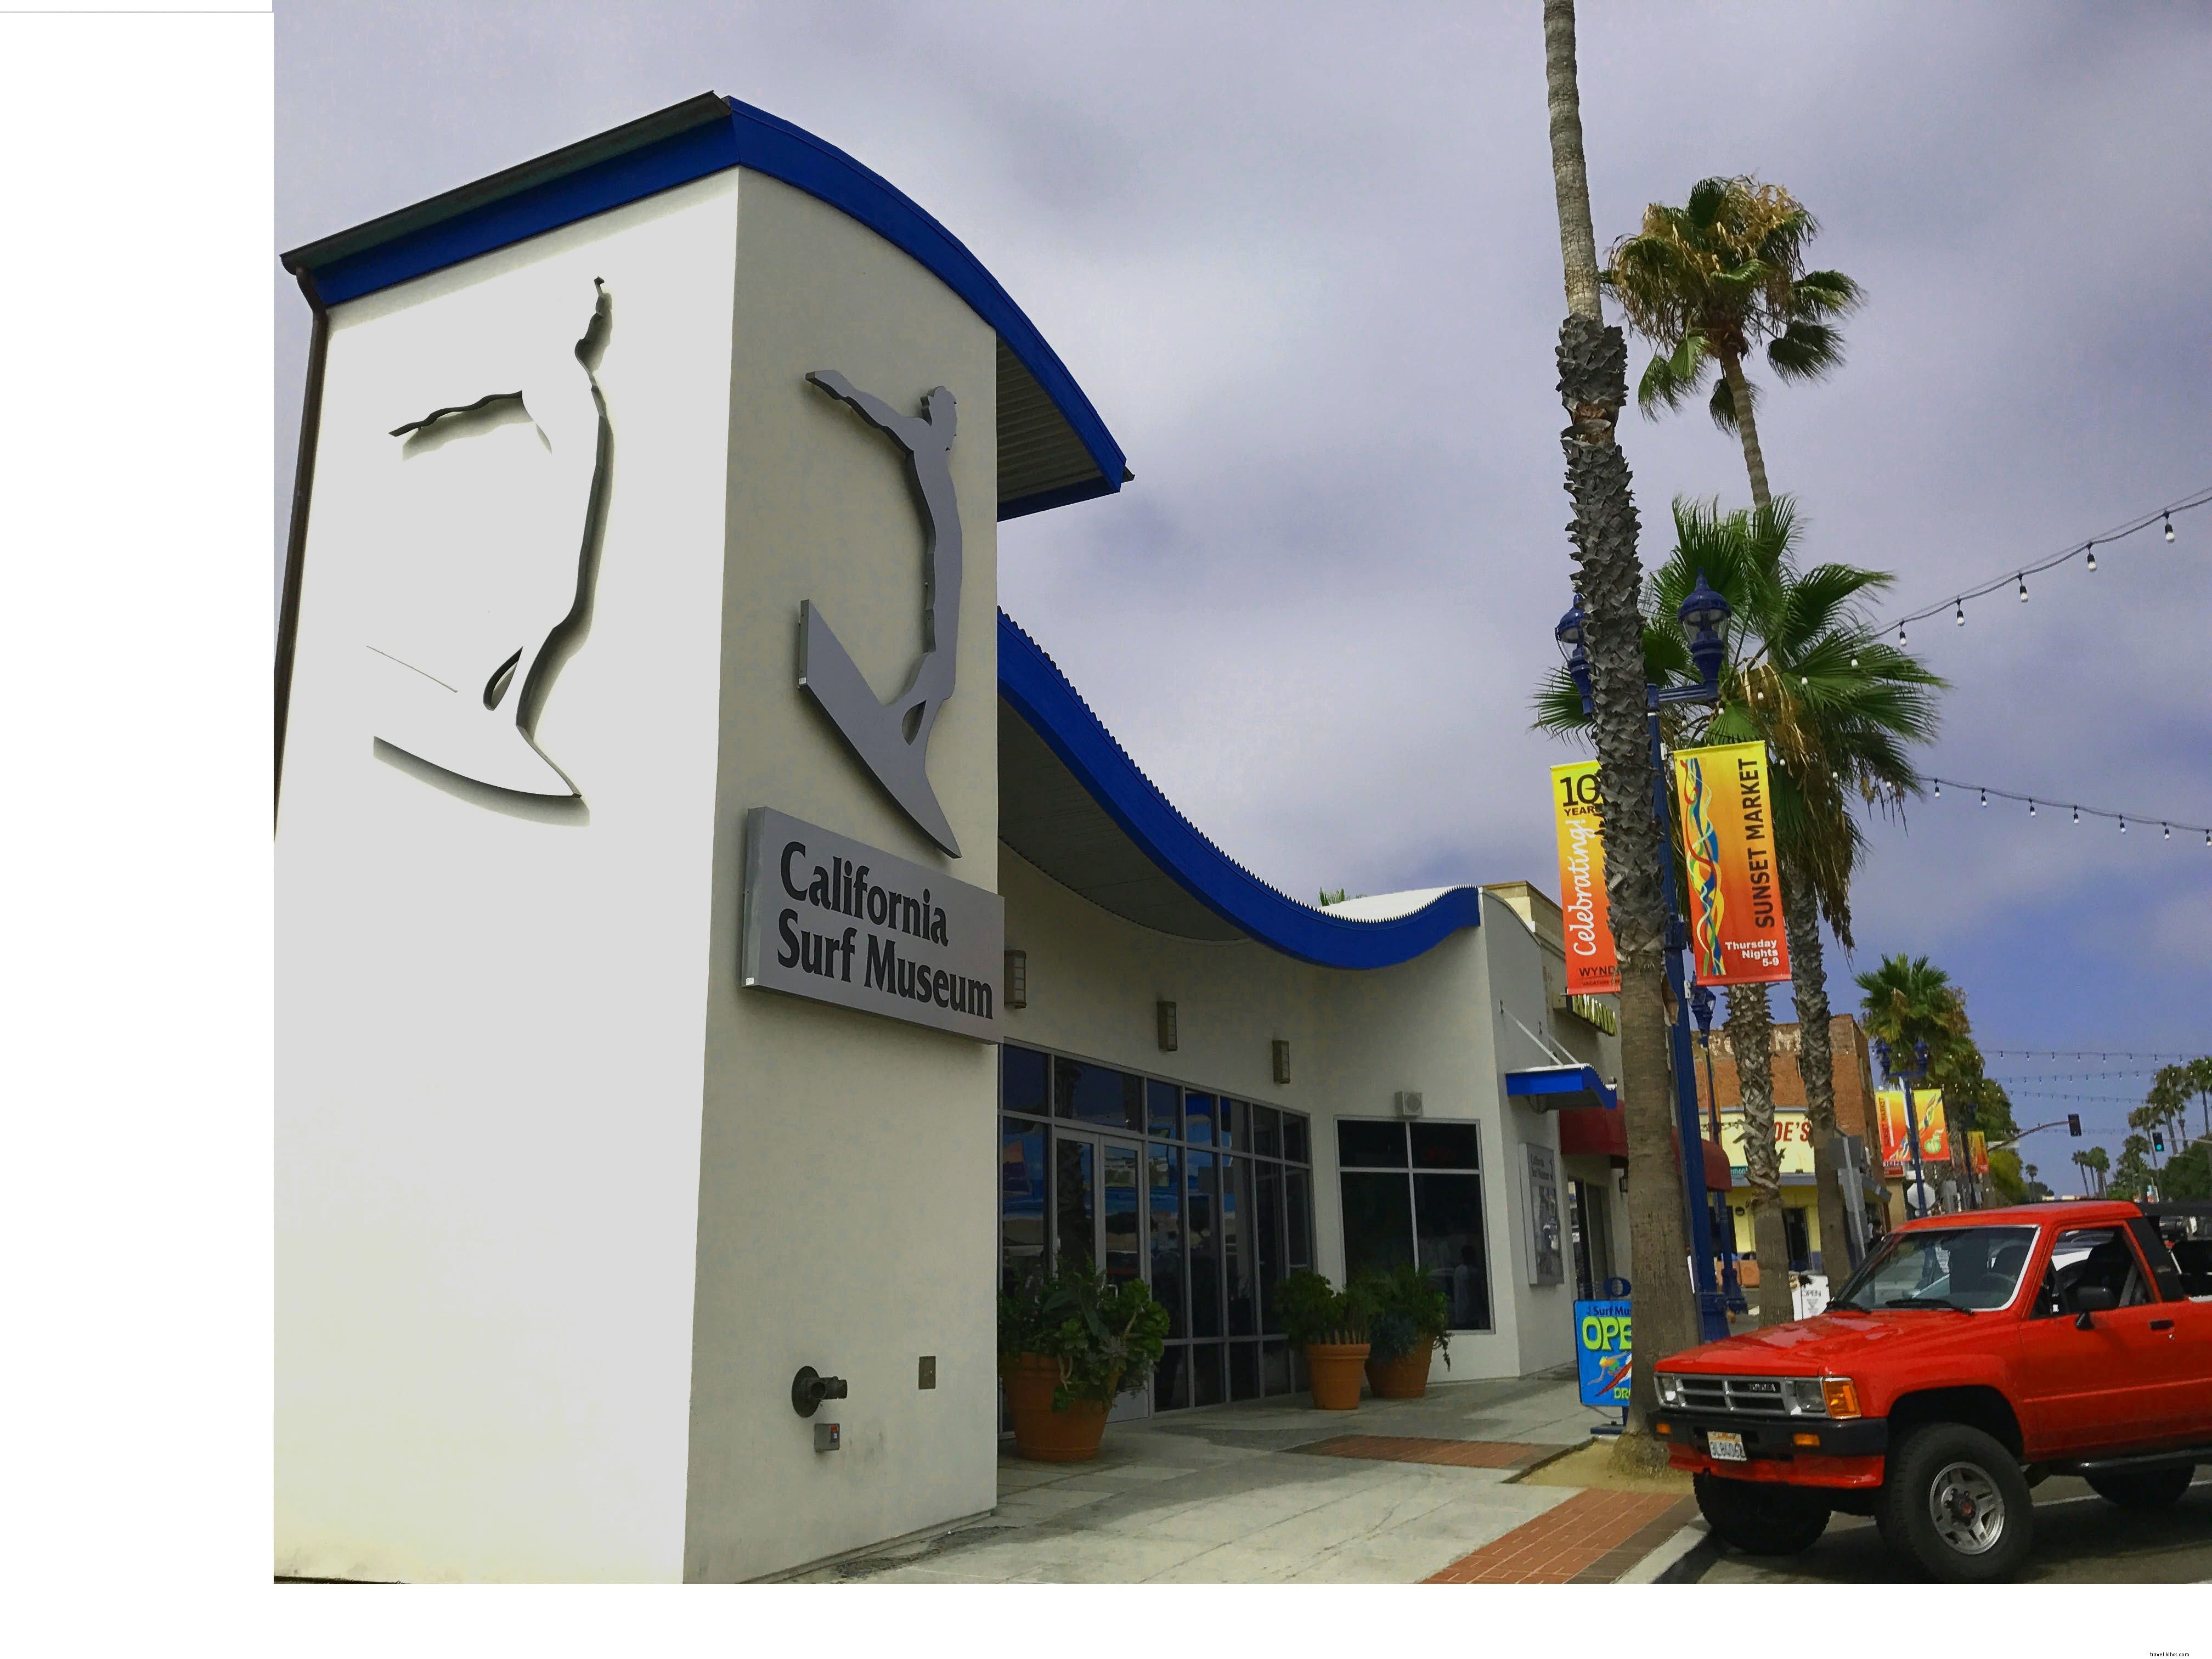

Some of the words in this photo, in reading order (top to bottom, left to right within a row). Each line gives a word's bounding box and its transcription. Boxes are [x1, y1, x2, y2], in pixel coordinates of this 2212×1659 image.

[1737, 758, 1765, 842] MARKET
[780, 841, 949, 947] California
[1565, 819, 1597, 956] Celebrating!
[1747, 847, 1775, 928] SUNSET
[777, 909, 857, 983] Surf
[864, 934, 994, 1020] Museum
[1725, 939, 1777, 950] Thursday
[1742, 949, 1779, 960] Nights
[1762, 957, 1779, 967] 5-9
[1593, 1306, 1613, 1316] Surf
